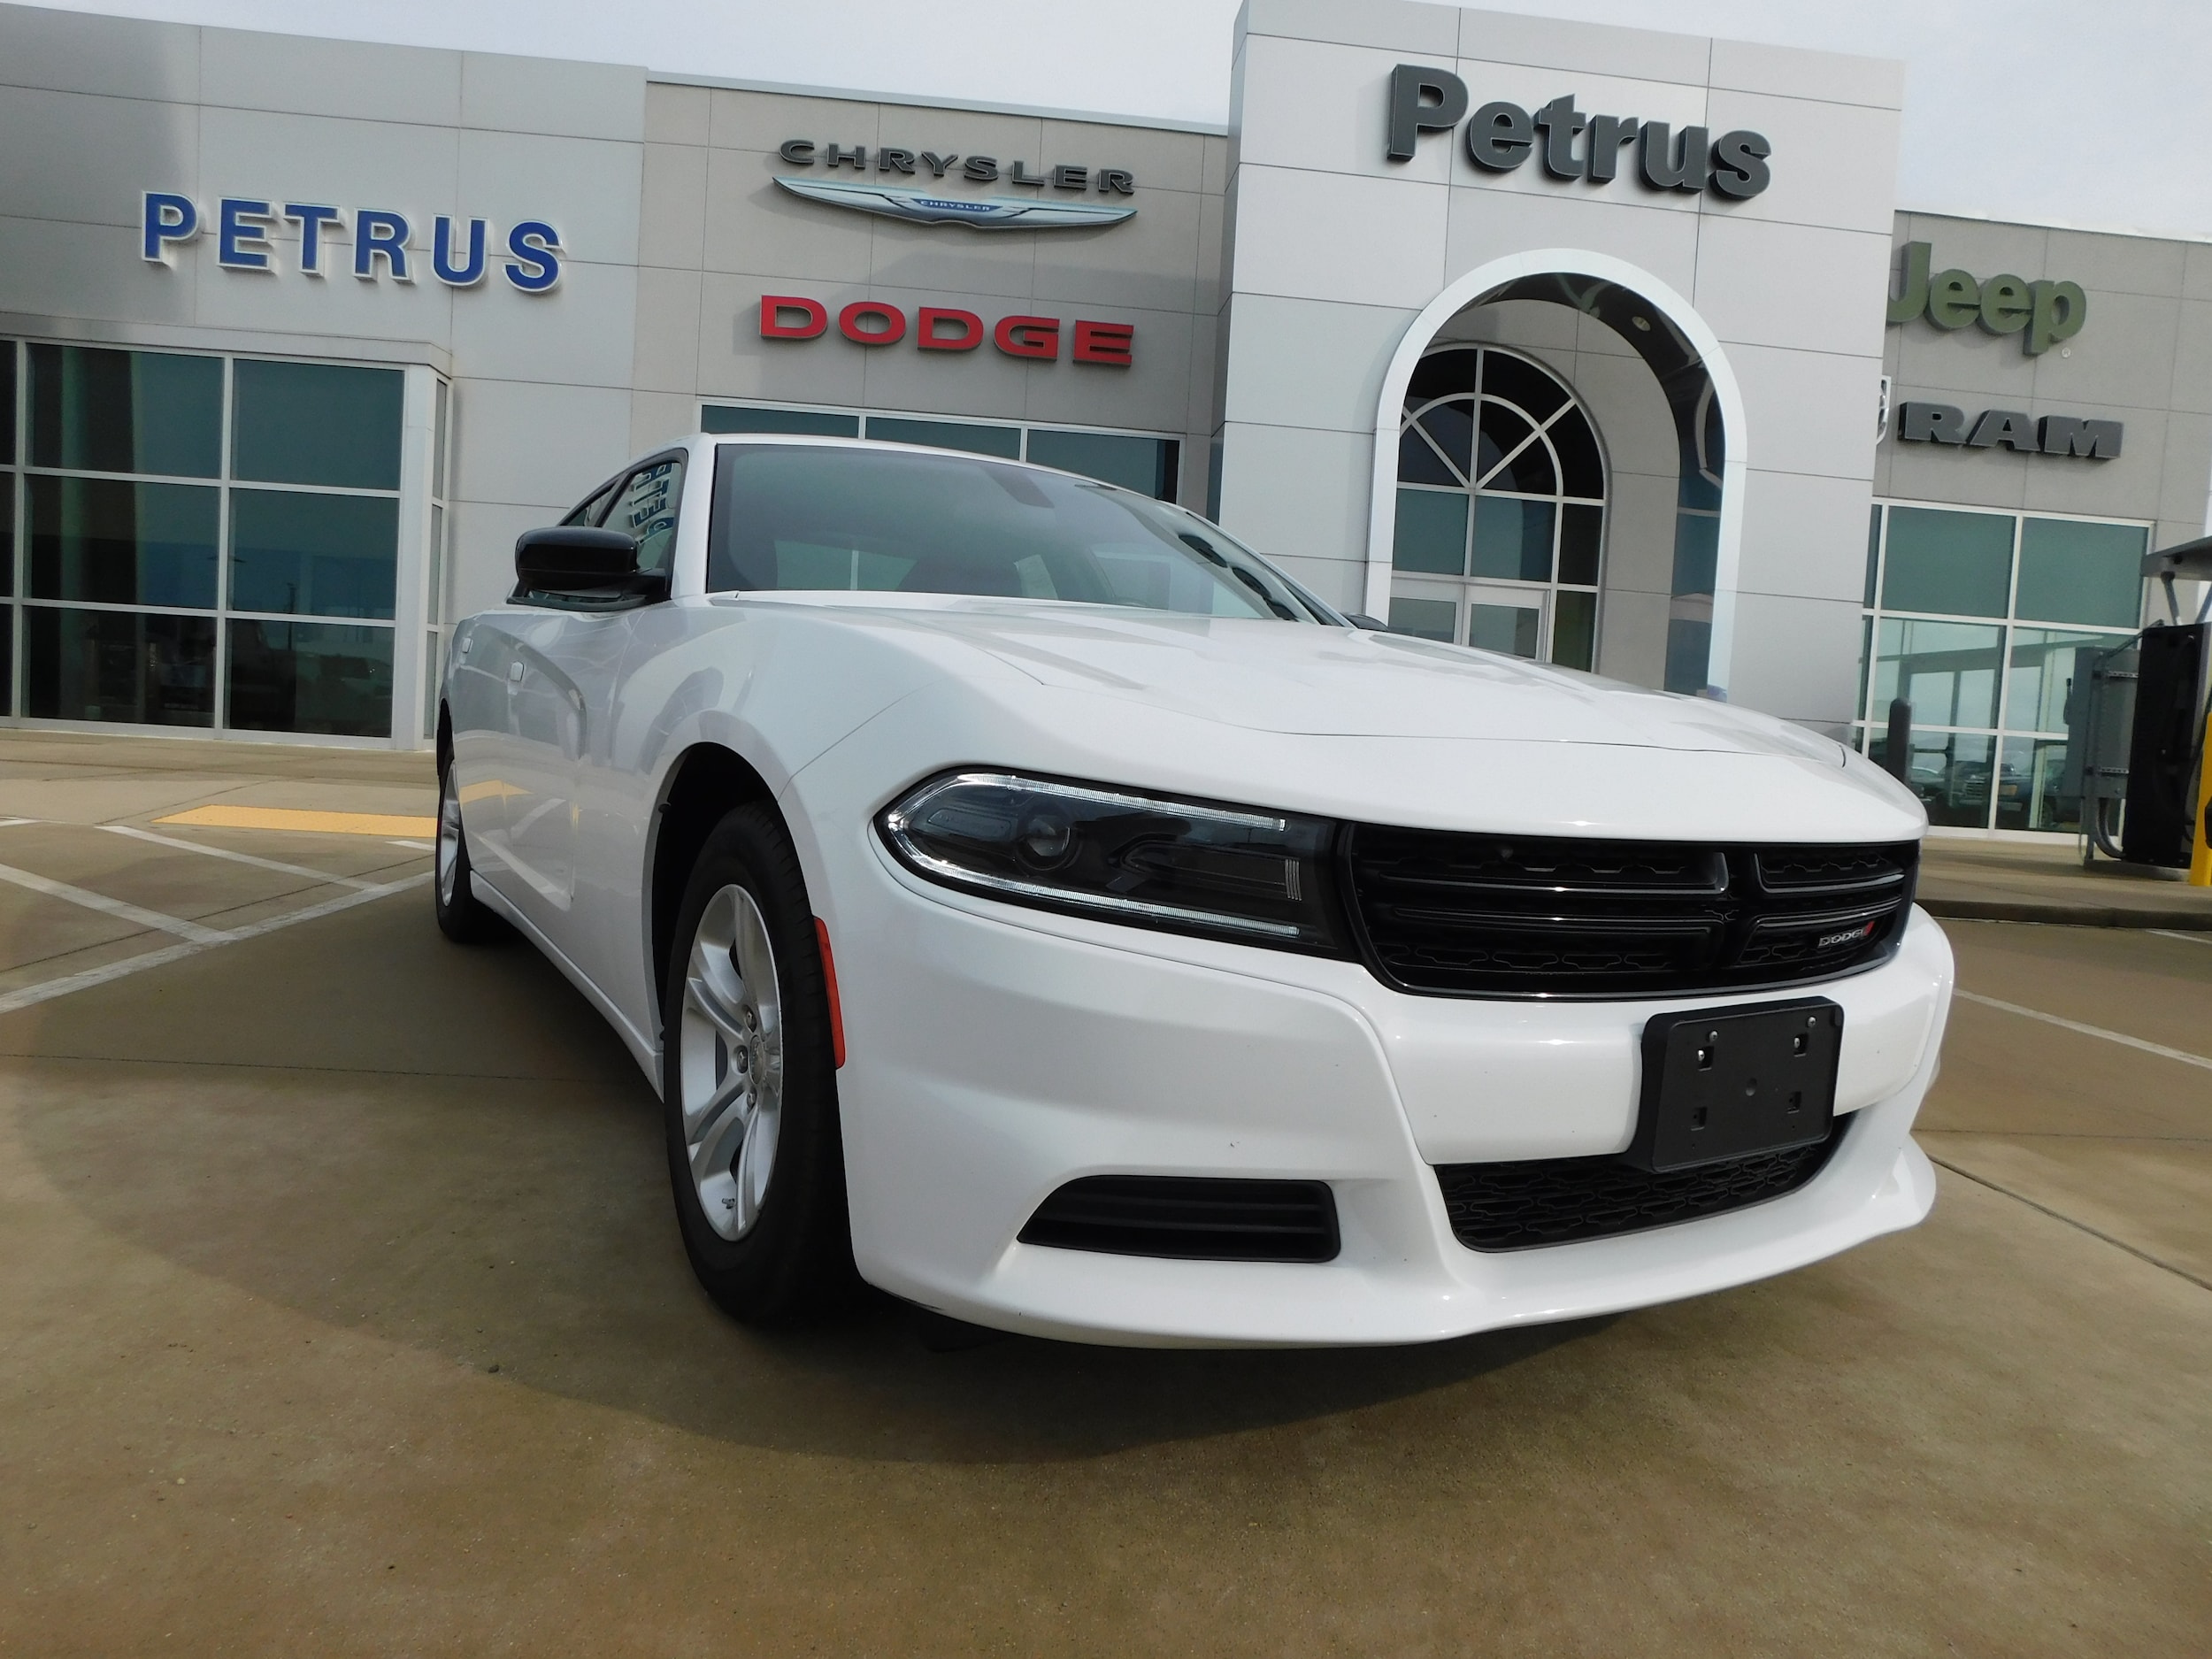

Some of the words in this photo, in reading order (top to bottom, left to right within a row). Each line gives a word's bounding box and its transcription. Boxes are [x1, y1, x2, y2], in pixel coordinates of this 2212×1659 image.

[780, 139, 1135, 195] CHRYSLER
[1386, 64, 1772, 200] Petrus
[141, 189, 566, 294] PETRUS
[920, 200, 990, 211] CHRYSLER
[759, 294, 1134, 367] DODGE
[1887, 241, 2086, 356] Jeep
[1898, 402, 2124, 459] RAM
